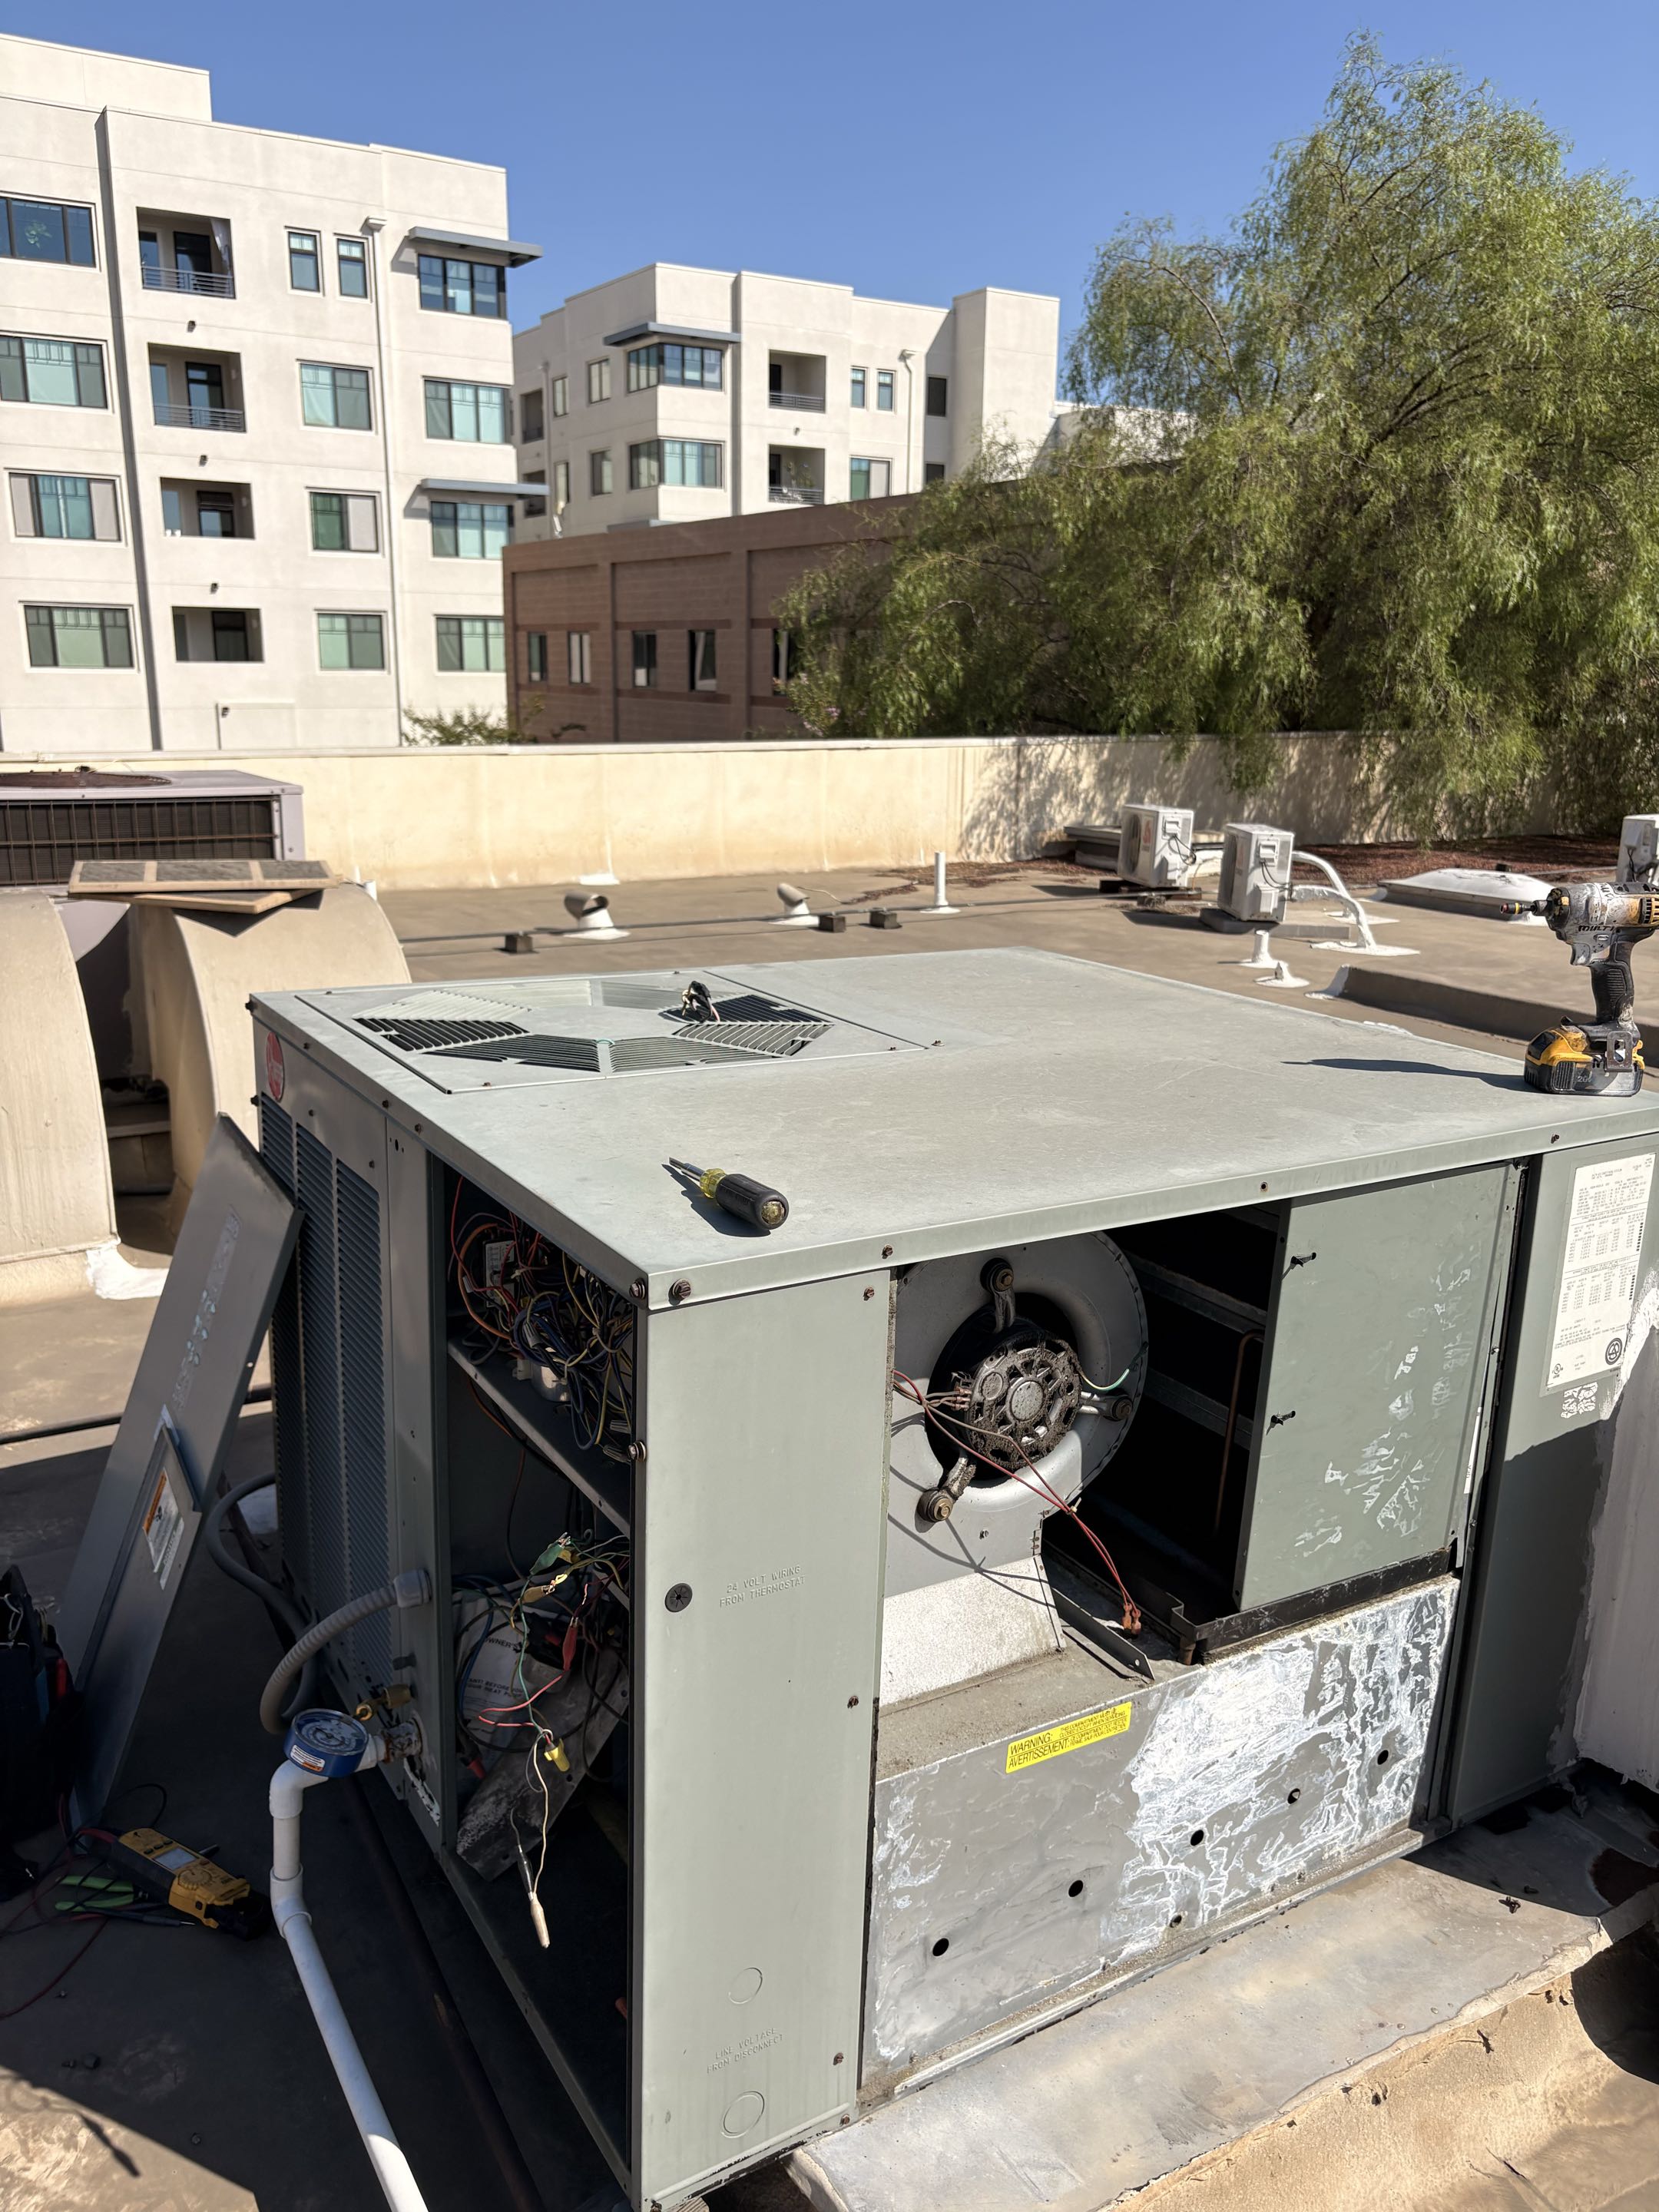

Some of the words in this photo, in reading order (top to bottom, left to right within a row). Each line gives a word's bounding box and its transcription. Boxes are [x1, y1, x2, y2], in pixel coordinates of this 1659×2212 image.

[720, 1592, 745, 1608] FROM
[750, 1575, 805, 1599] THERMOSTAT
[727, 1581, 738, 1594] 24
[743, 1574, 766, 1588] VOLT
[771, 1565, 800, 1581] WIRING
[1008, 1739, 1070, 1768] AVERTISSEMENT:
[1010, 1732, 1053, 1755] WARNING:
[707, 2058, 730, 2075] FROM
[734, 2033, 783, 2062] DISCONNECT
[715, 2046, 733, 2059] LINE
[739, 2028, 777, 2049] VOLTAGE
